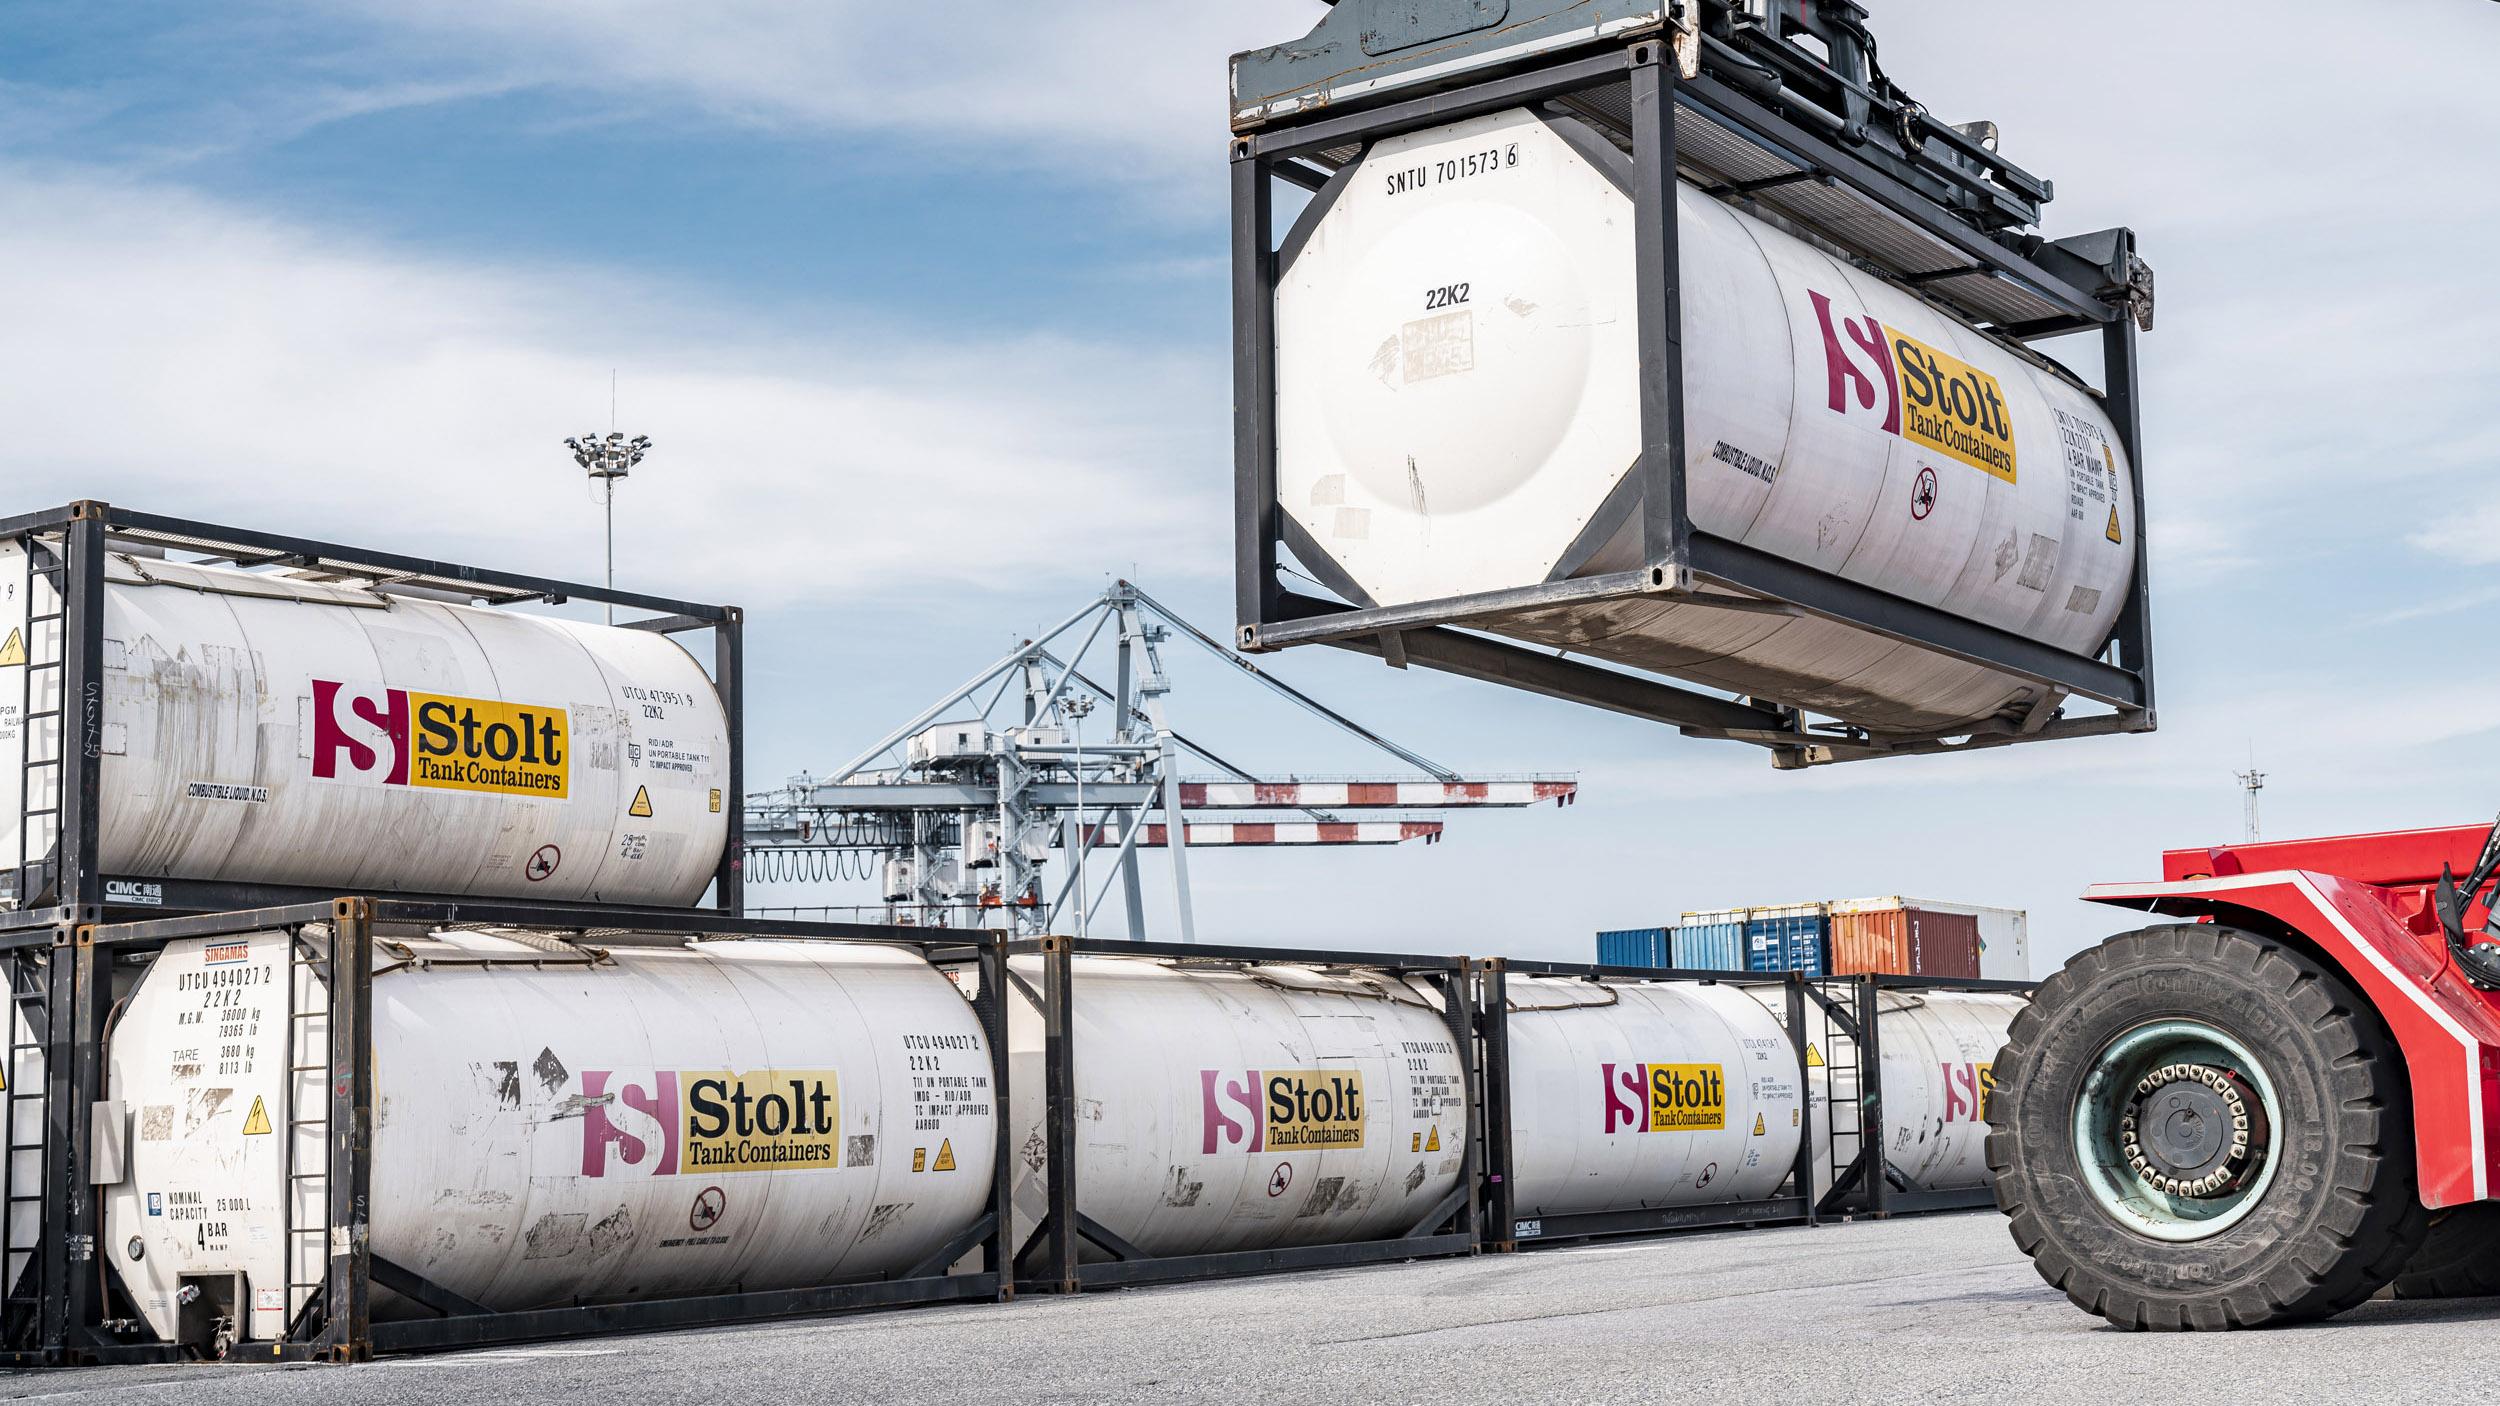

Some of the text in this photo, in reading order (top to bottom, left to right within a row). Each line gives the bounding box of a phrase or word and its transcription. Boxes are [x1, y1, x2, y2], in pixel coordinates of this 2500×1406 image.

[1387, 144, 1517, 195] SNTU 701573 6
[1426, 282, 1470, 310] 22K2
[1896, 339, 2008, 441] Stolt
[1907, 403, 2011, 473] Tank Containers
[8, 583, 15, 600] 9
[622, 686, 693, 706] UTCU 473951 9
[642, 704, 665, 720] 22K2
[418, 701, 561, 766] Stolt
[657, 751, 686, 761] PORTABLE
[686, 753, 700, 762] TANK
[418, 756, 561, 791] Tank Containers
[188, 783, 229, 799] COMBUSTIBLE
[106, 881, 142, 895] CIMC
[205, 946, 249, 962] SINGAMAS
[179, 966, 272, 991] UTCU 494027 2
[221, 1008, 247, 1021] 36000
[252, 1007, 261, 1022] kg
[219, 1023, 258, 1038] 79365 lb
[903, 1035, 979, 1050] UTCU 494027 2
[173, 1044, 255, 1062] TARE 3680 kg
[219, 1062, 239, 1075] 8113
[244, 1060, 253, 1074] lb
[927, 1077, 935, 1088] UN
[939, 1077, 968, 1088] PORTABLE
[971, 1077, 987, 1088] TANK
[1653, 1069, 1722, 1108] Stolt
[689, 1078, 833, 1139] Stolt
[1269, 1077, 1360, 1124] Stolt
[915, 1105, 989, 1116] TC IMPACT APPROVED
[1654, 1109, 1722, 1127] Tank Containers
[1270, 1124, 1360, 1145] Tank Containers
[690, 1139, 831, 1166] Tank Containers
[168, 1191, 202, 1205] NOMINAL
[170, 1207, 208, 1220] CAPACITY
[246, 1198, 251, 1211] L
[198, 1223, 206, 1251] 4
[207, 1223, 228, 1239] BAR
